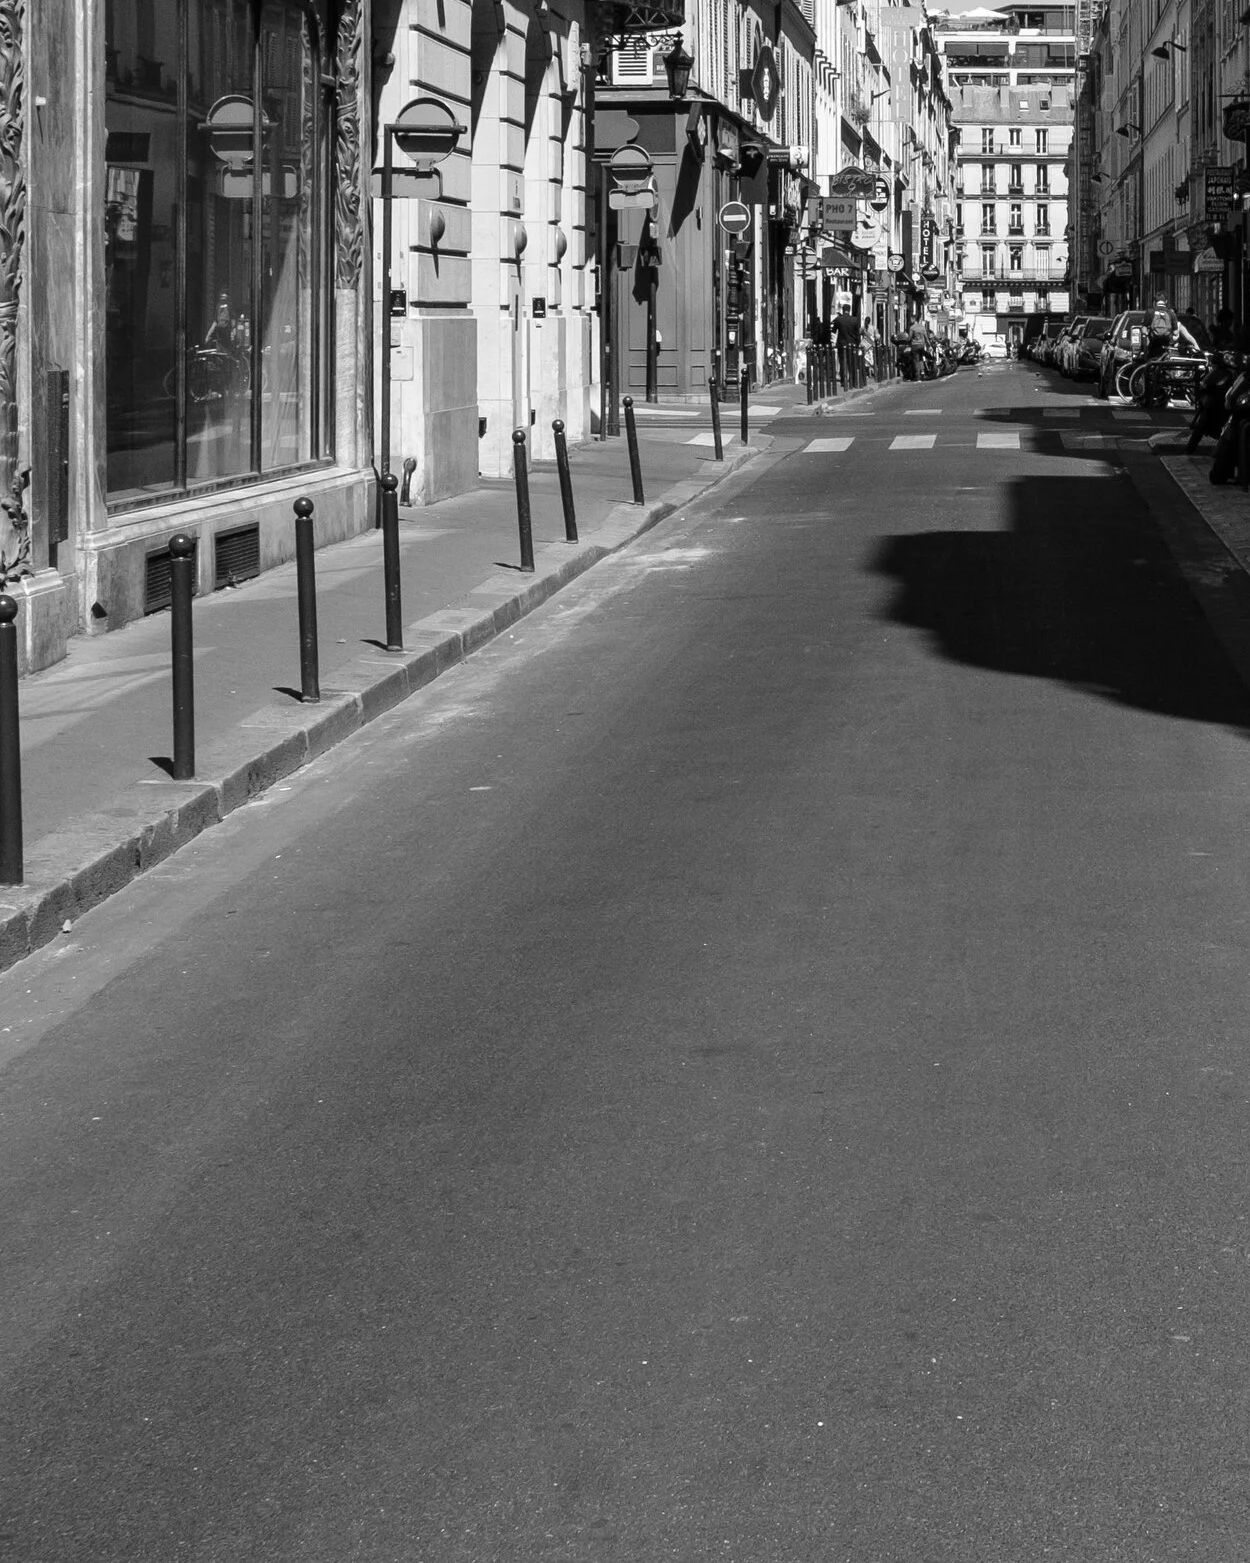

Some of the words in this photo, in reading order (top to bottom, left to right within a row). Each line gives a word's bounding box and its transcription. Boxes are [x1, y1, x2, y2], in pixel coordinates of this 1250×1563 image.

[892, 30, 908, 120] HOTEL
[826, 204, 845, 214] PHO
[848, 204, 855, 214] 7
[923, 220, 931, 265] HOTEL
[826, 267, 850, 277] BAR
